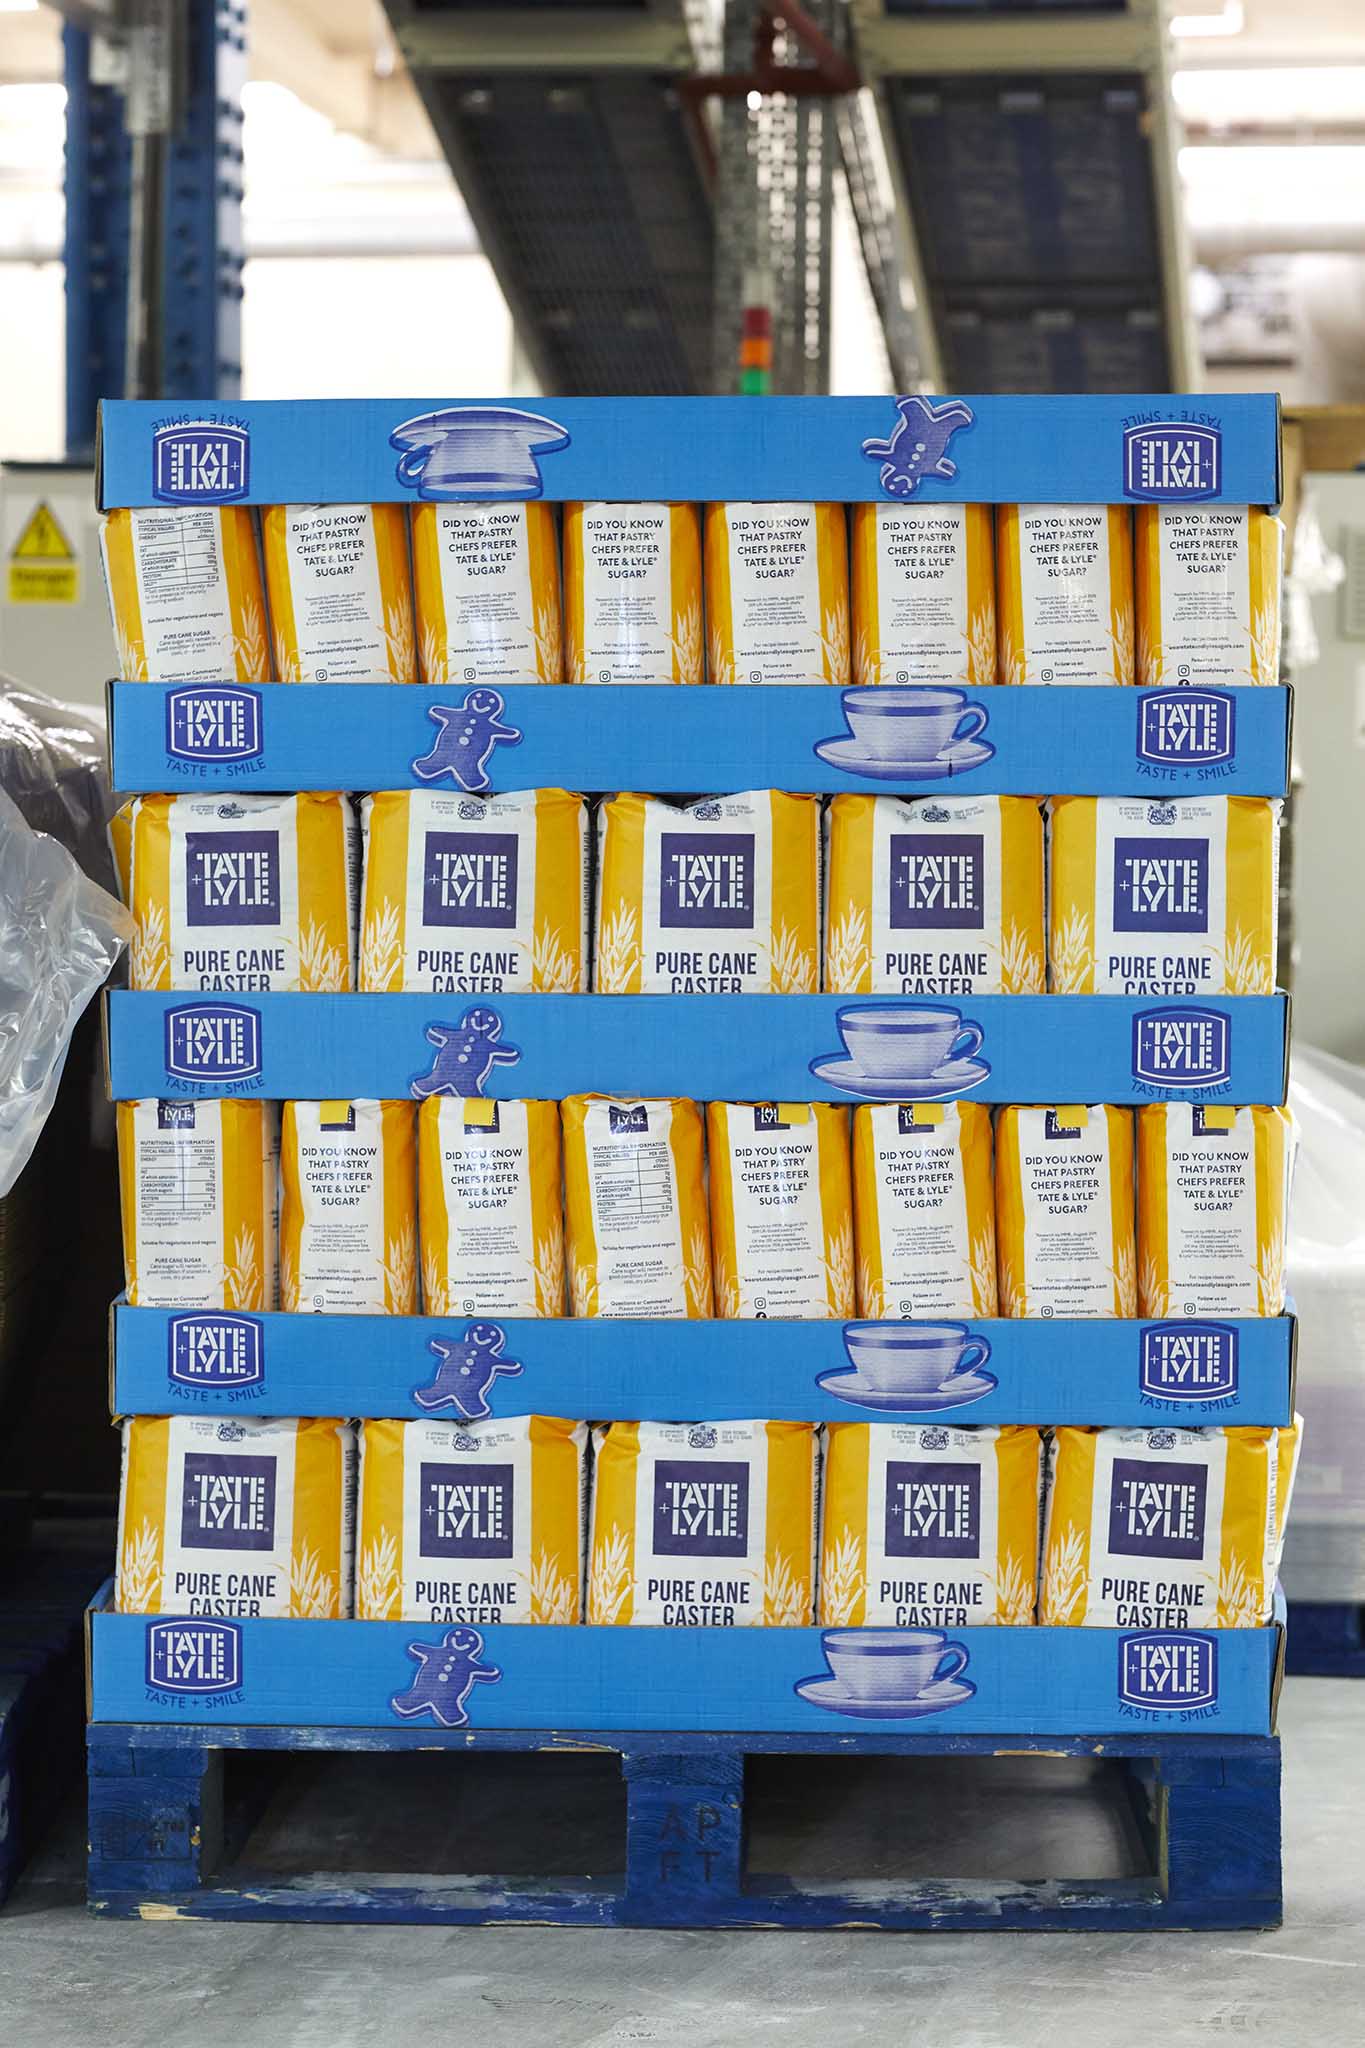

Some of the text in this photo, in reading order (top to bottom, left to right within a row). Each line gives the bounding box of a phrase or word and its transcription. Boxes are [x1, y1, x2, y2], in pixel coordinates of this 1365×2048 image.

[151, 414, 191, 433] SMILE
[210, 413, 251, 432] TASTE
[1121, 410, 1160, 430] SMILE
[1181, 410, 1222, 430] TASTE
[171, 467, 234, 490] TATE
[1142, 465, 1206, 487] TATE
[588, 521, 603, 529] DID
[630, 520, 663, 528] KNOW
[1165, 516, 1242, 525] DID YOU KNOW
[594, 533, 653, 541] THAT PASTRY
[1173, 528, 1234, 536] THAT PASTRY
[592, 545, 659, 554] CHEFS PREFER
[1170, 540, 1238, 549] CHEFS PREFER
[598, 558, 619, 566] TATE
[622, 558, 629, 566] &
[1176, 553, 1198, 561] TATE
[608, 570, 646, 578] SUGAR?
[1187, 565, 1225, 573] SUGAR?
[180, 700, 244, 723] TATE
[1153, 704, 1217, 727] TATE
[165, 758, 207, 777] TASTE
[226, 758, 267, 777] SMILE
[1136, 762, 1177, 781] TASTE
[1197, 762, 1238, 781] SMILE
[197, 853, 268, 878] TATE
[436, 854, 506, 880] TATE
[672, 855, 743, 881] TATE
[901, 856, 972, 881] TATE
[1125, 859, 1197, 885] TATE
[185, 949, 284, 972] PURE CANE
[418, 951, 518, 974] PURE CANE
[656, 952, 757, 974] PURE CANE
[887, 954, 987, 975] PURE CANE
[1109, 957, 1211, 979] PURE CANE
[200, 974, 270, 991] CASTER
[432, 976, 503, 992] CASTER
[672, 977, 742, 993] CASTER
[902, 978, 972, 993] CASTER
[1125, 981, 1196, 995] CASTER
[179, 1018, 243, 1040] TATE
[1148, 1022, 1212, 1045] TATE
[164, 1076, 206, 1094] TASTE
[225, 1076, 265, 1093] SMILE
[1131, 1080, 1173, 1099] TASTE
[1192, 1080, 1233, 1099] SMILE
[880, 1148, 954, 1160] DID YOU KNOW
[888, 1161, 949, 1172] THAT PASTRY
[886, 1173, 954, 1184] CHEFS PREFER
[893, 1188, 915, 1196] TATE
[917, 1187, 924, 1195] &
[904, 1199, 943, 1208] SUGAR?
[183, 1326, 245, 1349] TATE
[1155, 1337, 1220, 1359] TATE
[168, 1383, 209, 1401] TASTE
[228, 1383, 267, 1402] SMILE
[1139, 1393, 1180, 1412] TASTE
[1200, 1393, 1241, 1412] SMILE
[194, 1475, 264, 1503] TATE
[431, 1485, 502, 1511] TATE
[666, 1482, 737, 1509] TATE
[897, 1484, 969, 1510] TATE
[1123, 1481, 1195, 1511] TATE
[176, 1572, 276, 1597] PURE CANE
[416, 1581, 516, 1604] PURE CANE
[649, 1579, 750, 1603] PURE CANE
[881, 1581, 982, 1605] PURE CANE
[1102, 1578, 1204, 1606] PURE CANE
[190, 1598, 261, 1617] CASTER
[431, 1607, 501, 1623] CASTER
[663, 1605, 734, 1626] CASTER
[896, 1606, 967, 1626] CASTER
[1117, 1605, 1188, 1628] CASTER
[160, 1632, 224, 1655] TATE
[1134, 1645, 1199, 1668] TATE
[144, 1688, 186, 1709] TASTE
[205, 1690, 246, 1709] SMILE
[1118, 1702, 1160, 1722] TASTE
[1180, 1703, 1220, 1722] SMILE
